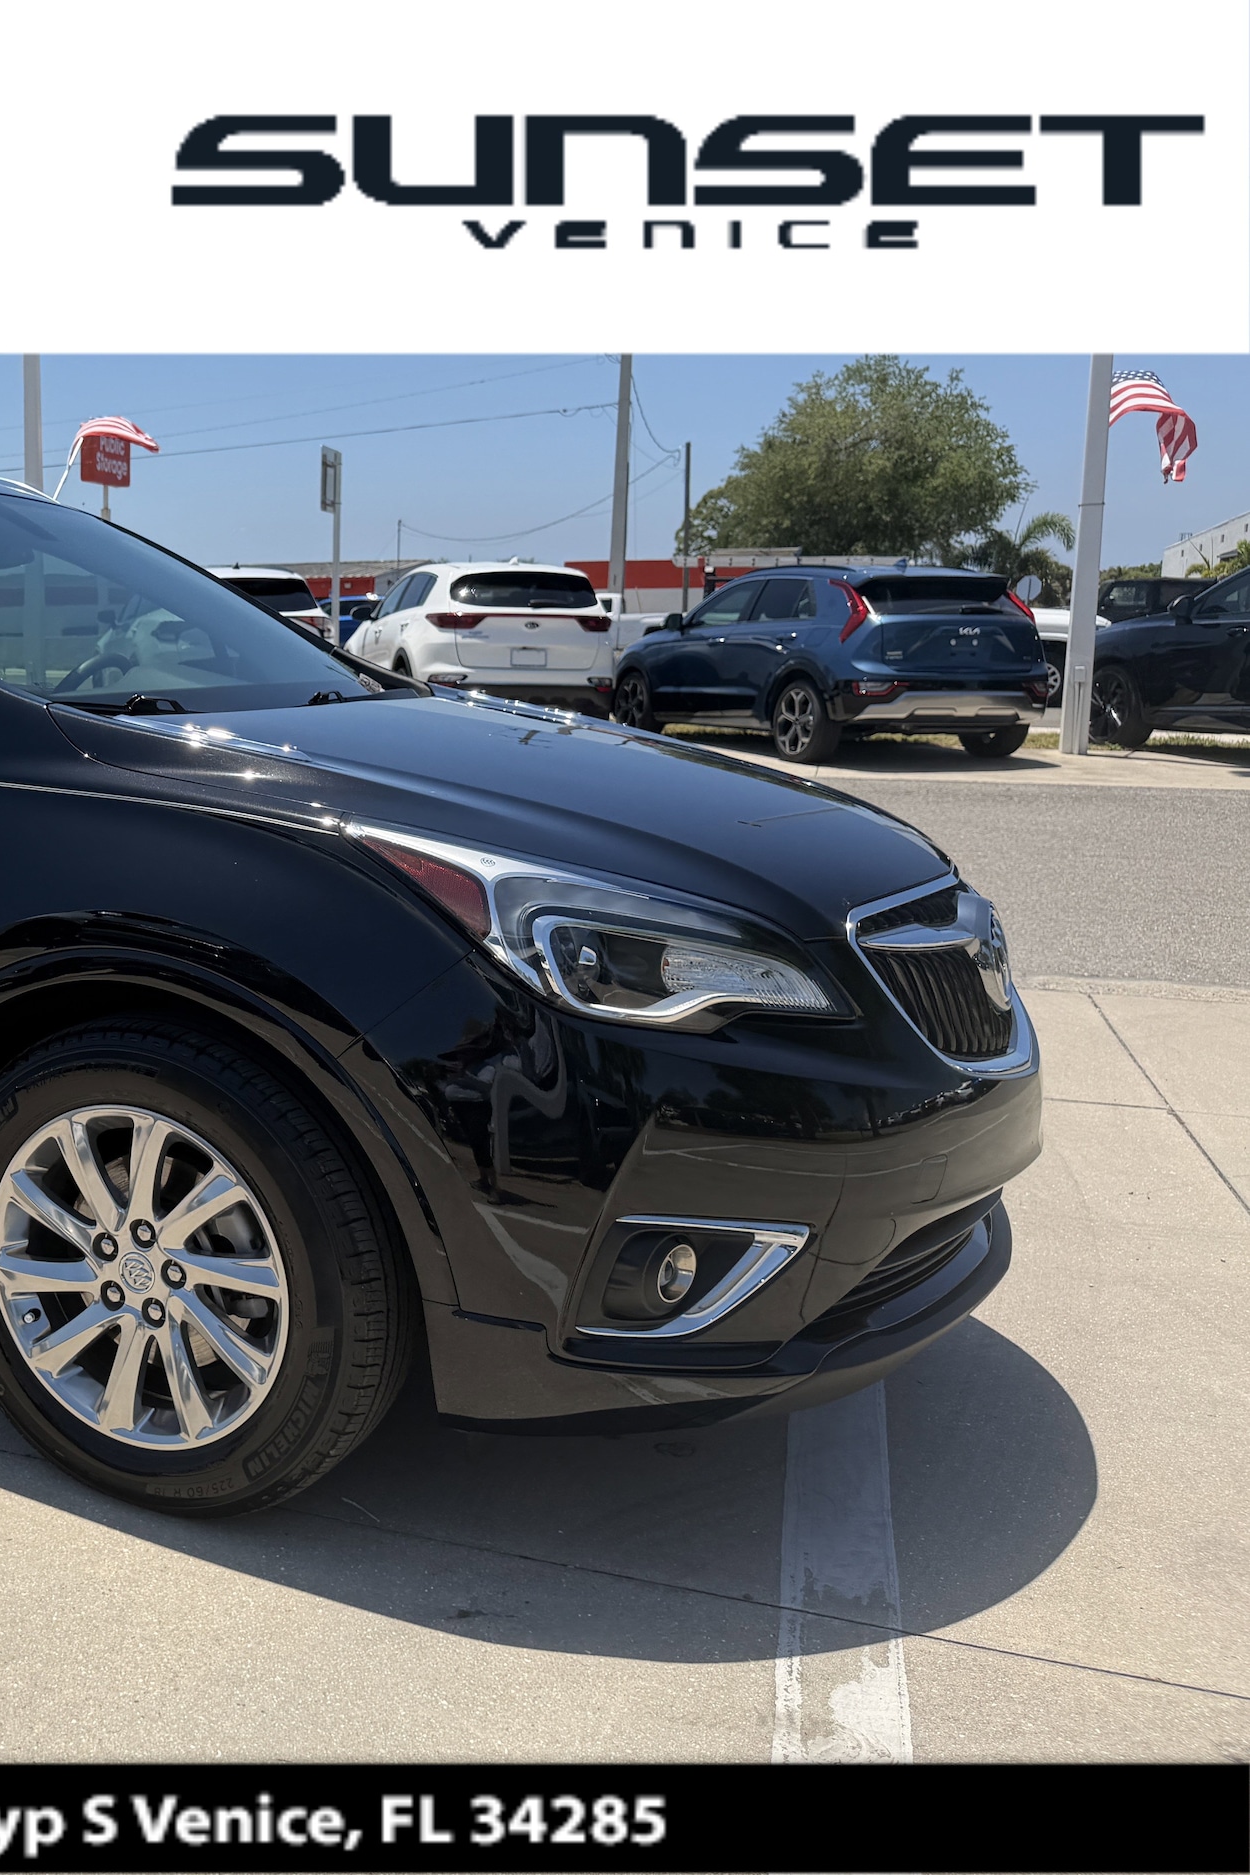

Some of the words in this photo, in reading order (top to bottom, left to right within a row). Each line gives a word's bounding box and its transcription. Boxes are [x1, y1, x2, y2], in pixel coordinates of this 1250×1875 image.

[99, 436, 125, 456] Public
[95, 451, 128, 481] Storage
[958, 626, 981, 636] KIA
[246, 1378, 321, 1478] MICHELIN
[187, 1477, 235, 1498] 225/60
